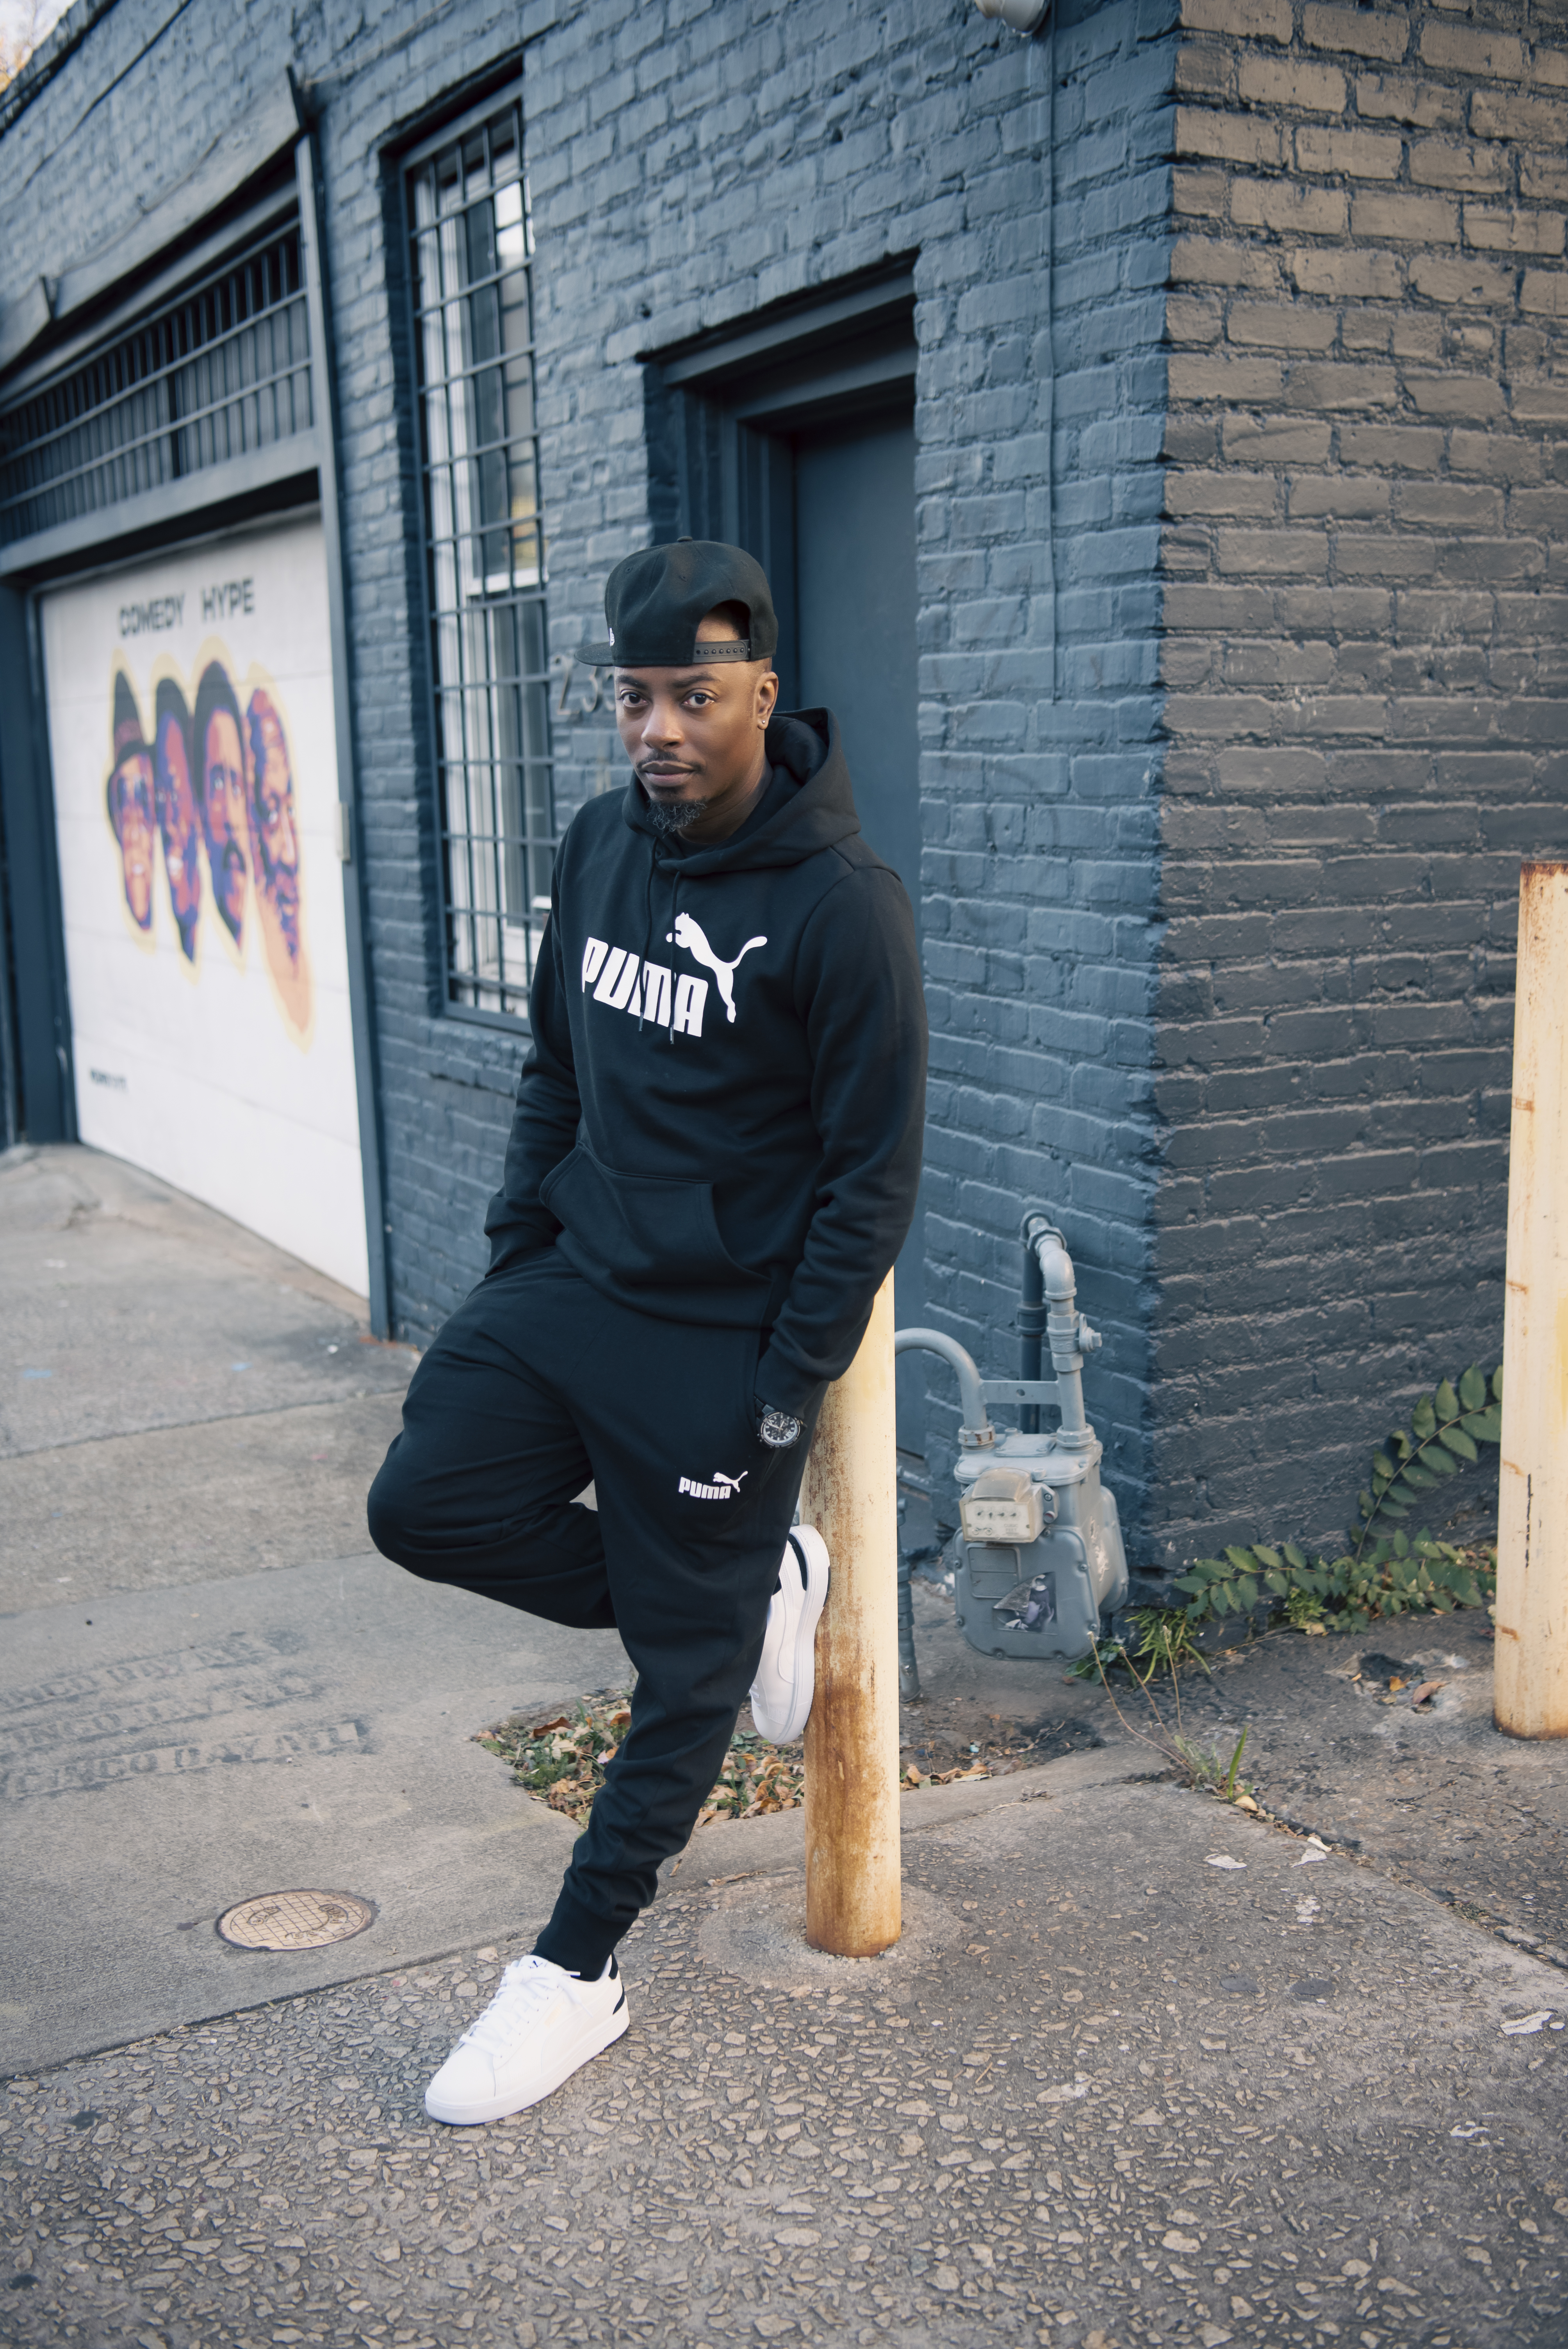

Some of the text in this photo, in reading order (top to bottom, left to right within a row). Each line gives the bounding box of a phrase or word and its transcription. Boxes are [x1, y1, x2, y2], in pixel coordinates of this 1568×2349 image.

[120, 577, 255, 640] COMEDY HYPE
[582, 937, 708, 1037] PUMA
[679, 1476, 731, 1499] PUMA
